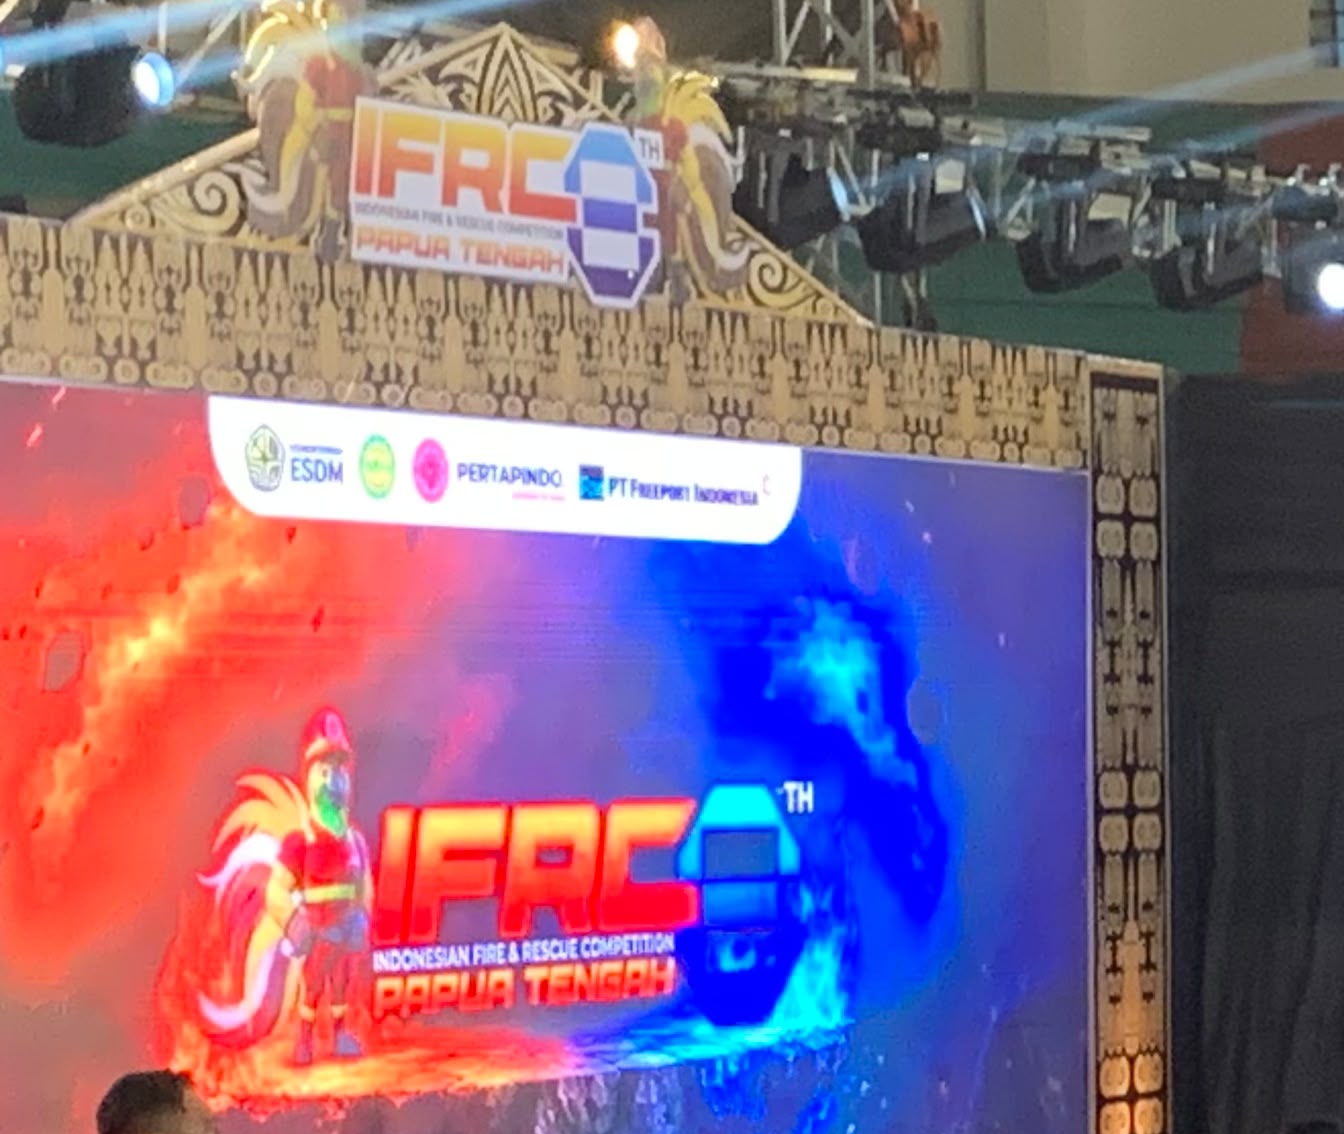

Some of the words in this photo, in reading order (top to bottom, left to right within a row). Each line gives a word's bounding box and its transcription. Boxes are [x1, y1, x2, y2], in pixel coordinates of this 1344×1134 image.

[354, 107, 578, 222] IFRC
[639, 134, 661, 158] TH
[355, 225, 451, 261] PAPUA
[460, 239, 565, 273] TENGAH
[290, 458, 343, 484] ESDM
[457, 462, 563, 488] PERTAPINDO
[609, 476, 628, 498] PT
[370, 797, 699, 946] IFRC
[783, 781, 815, 813] TH
[373, 943, 470, 972] INDONESIAN
[472, 941, 506, 966] FIRE
[508, 941, 520, 964] &
[521, 937, 578, 962] RESCUE
[582, 932, 675, 960] COMPETITION
[373, 969, 515, 1018] PAPUA
[523, 957, 676, 1008] TENGAH
